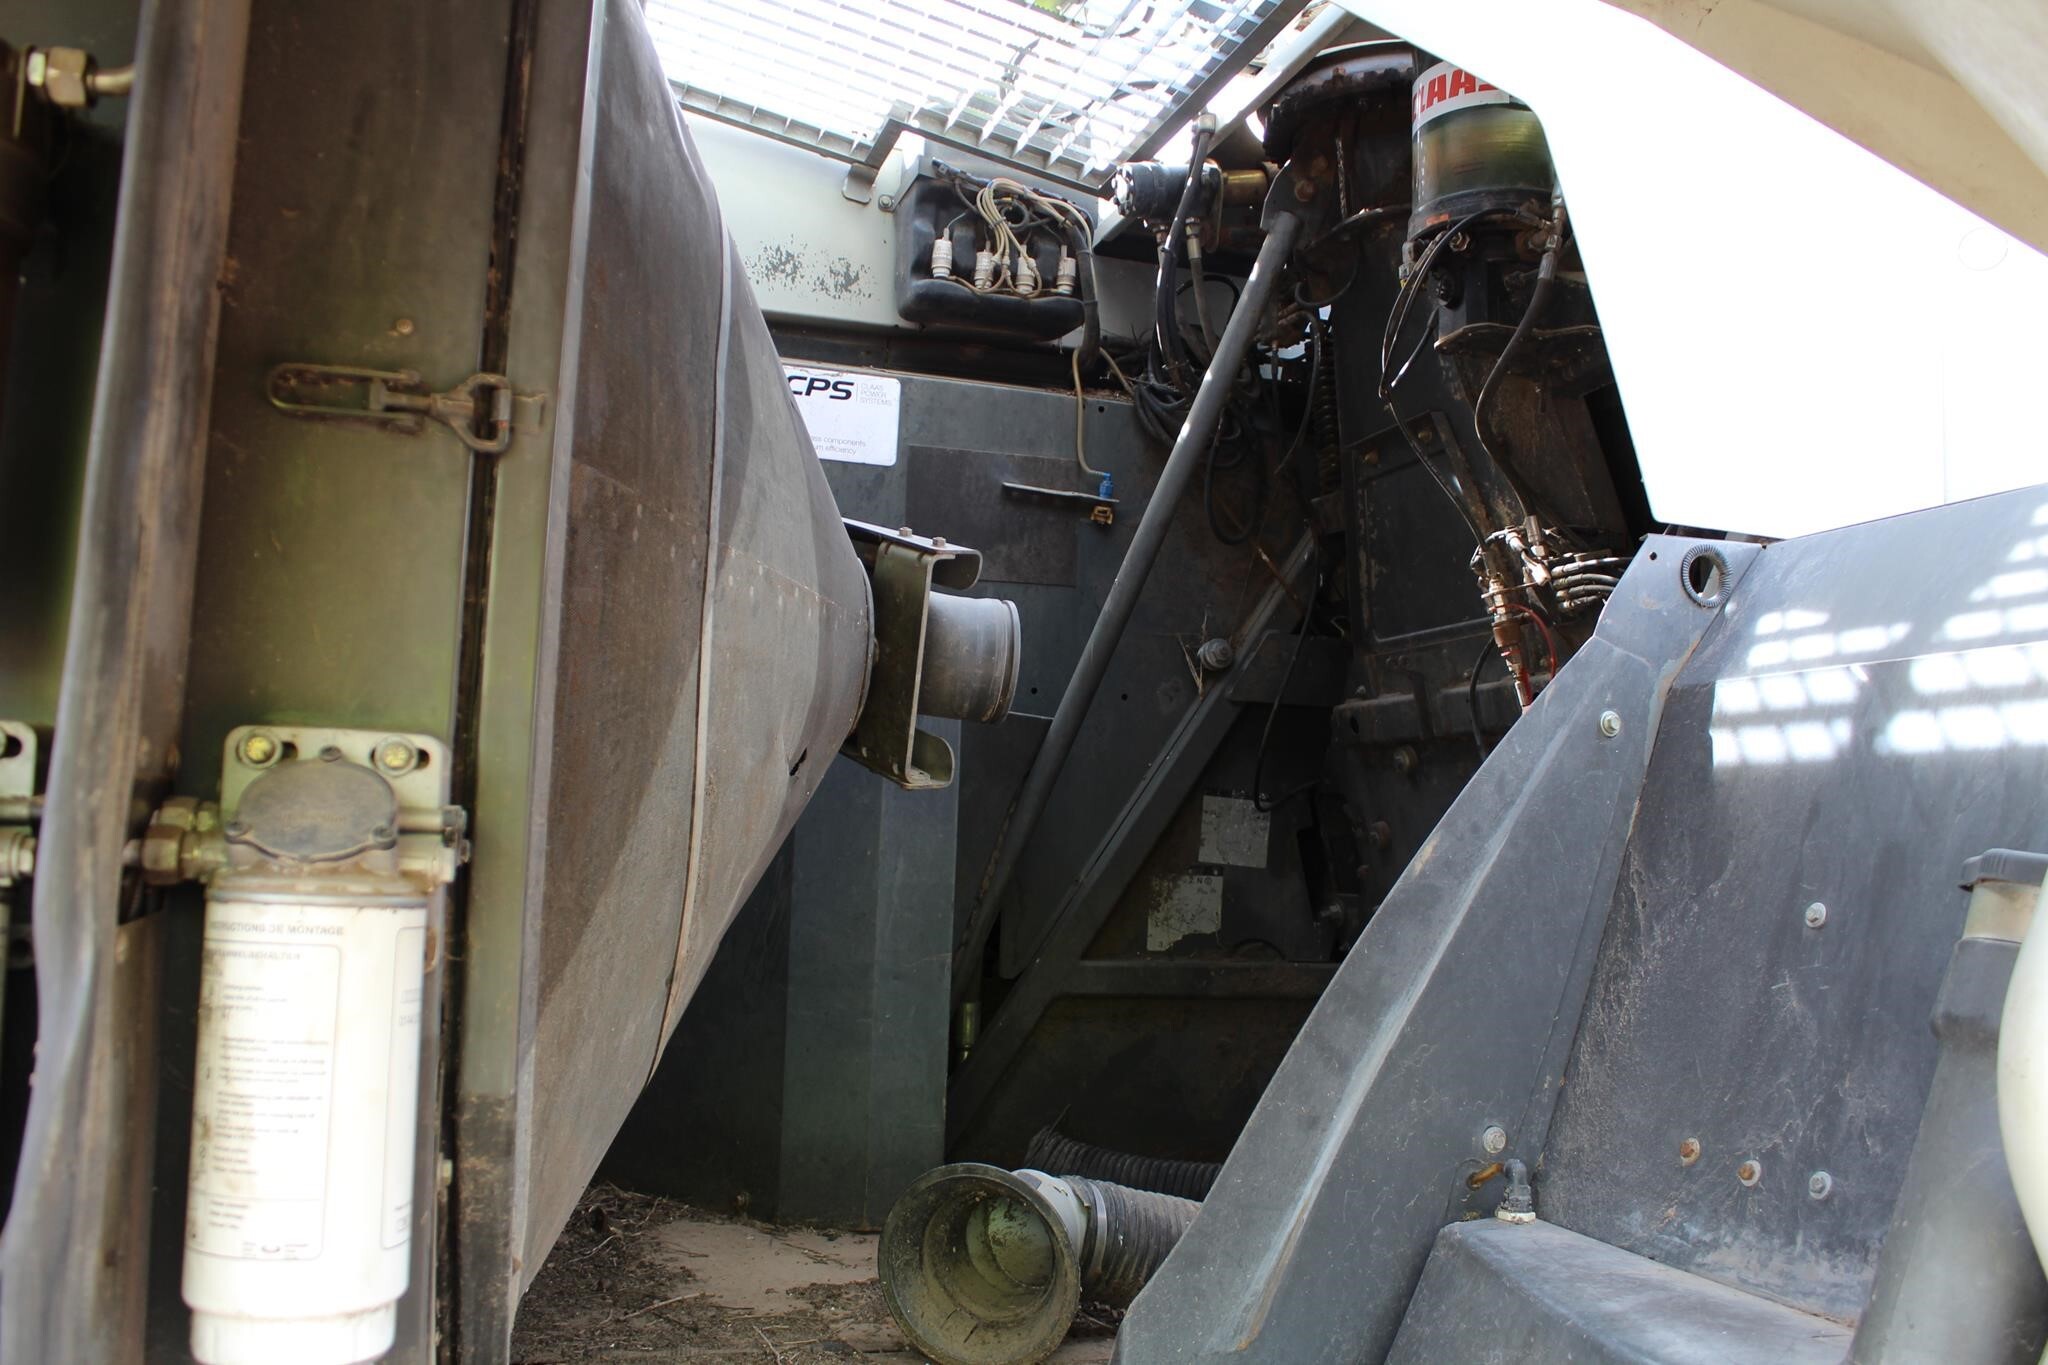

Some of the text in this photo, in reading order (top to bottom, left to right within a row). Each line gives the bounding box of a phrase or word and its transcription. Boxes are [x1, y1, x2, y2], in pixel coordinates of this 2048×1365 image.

[787, 375, 855, 400] CPS
[823, 436, 866, 447] components
[825, 444, 857, 455] efficiency
